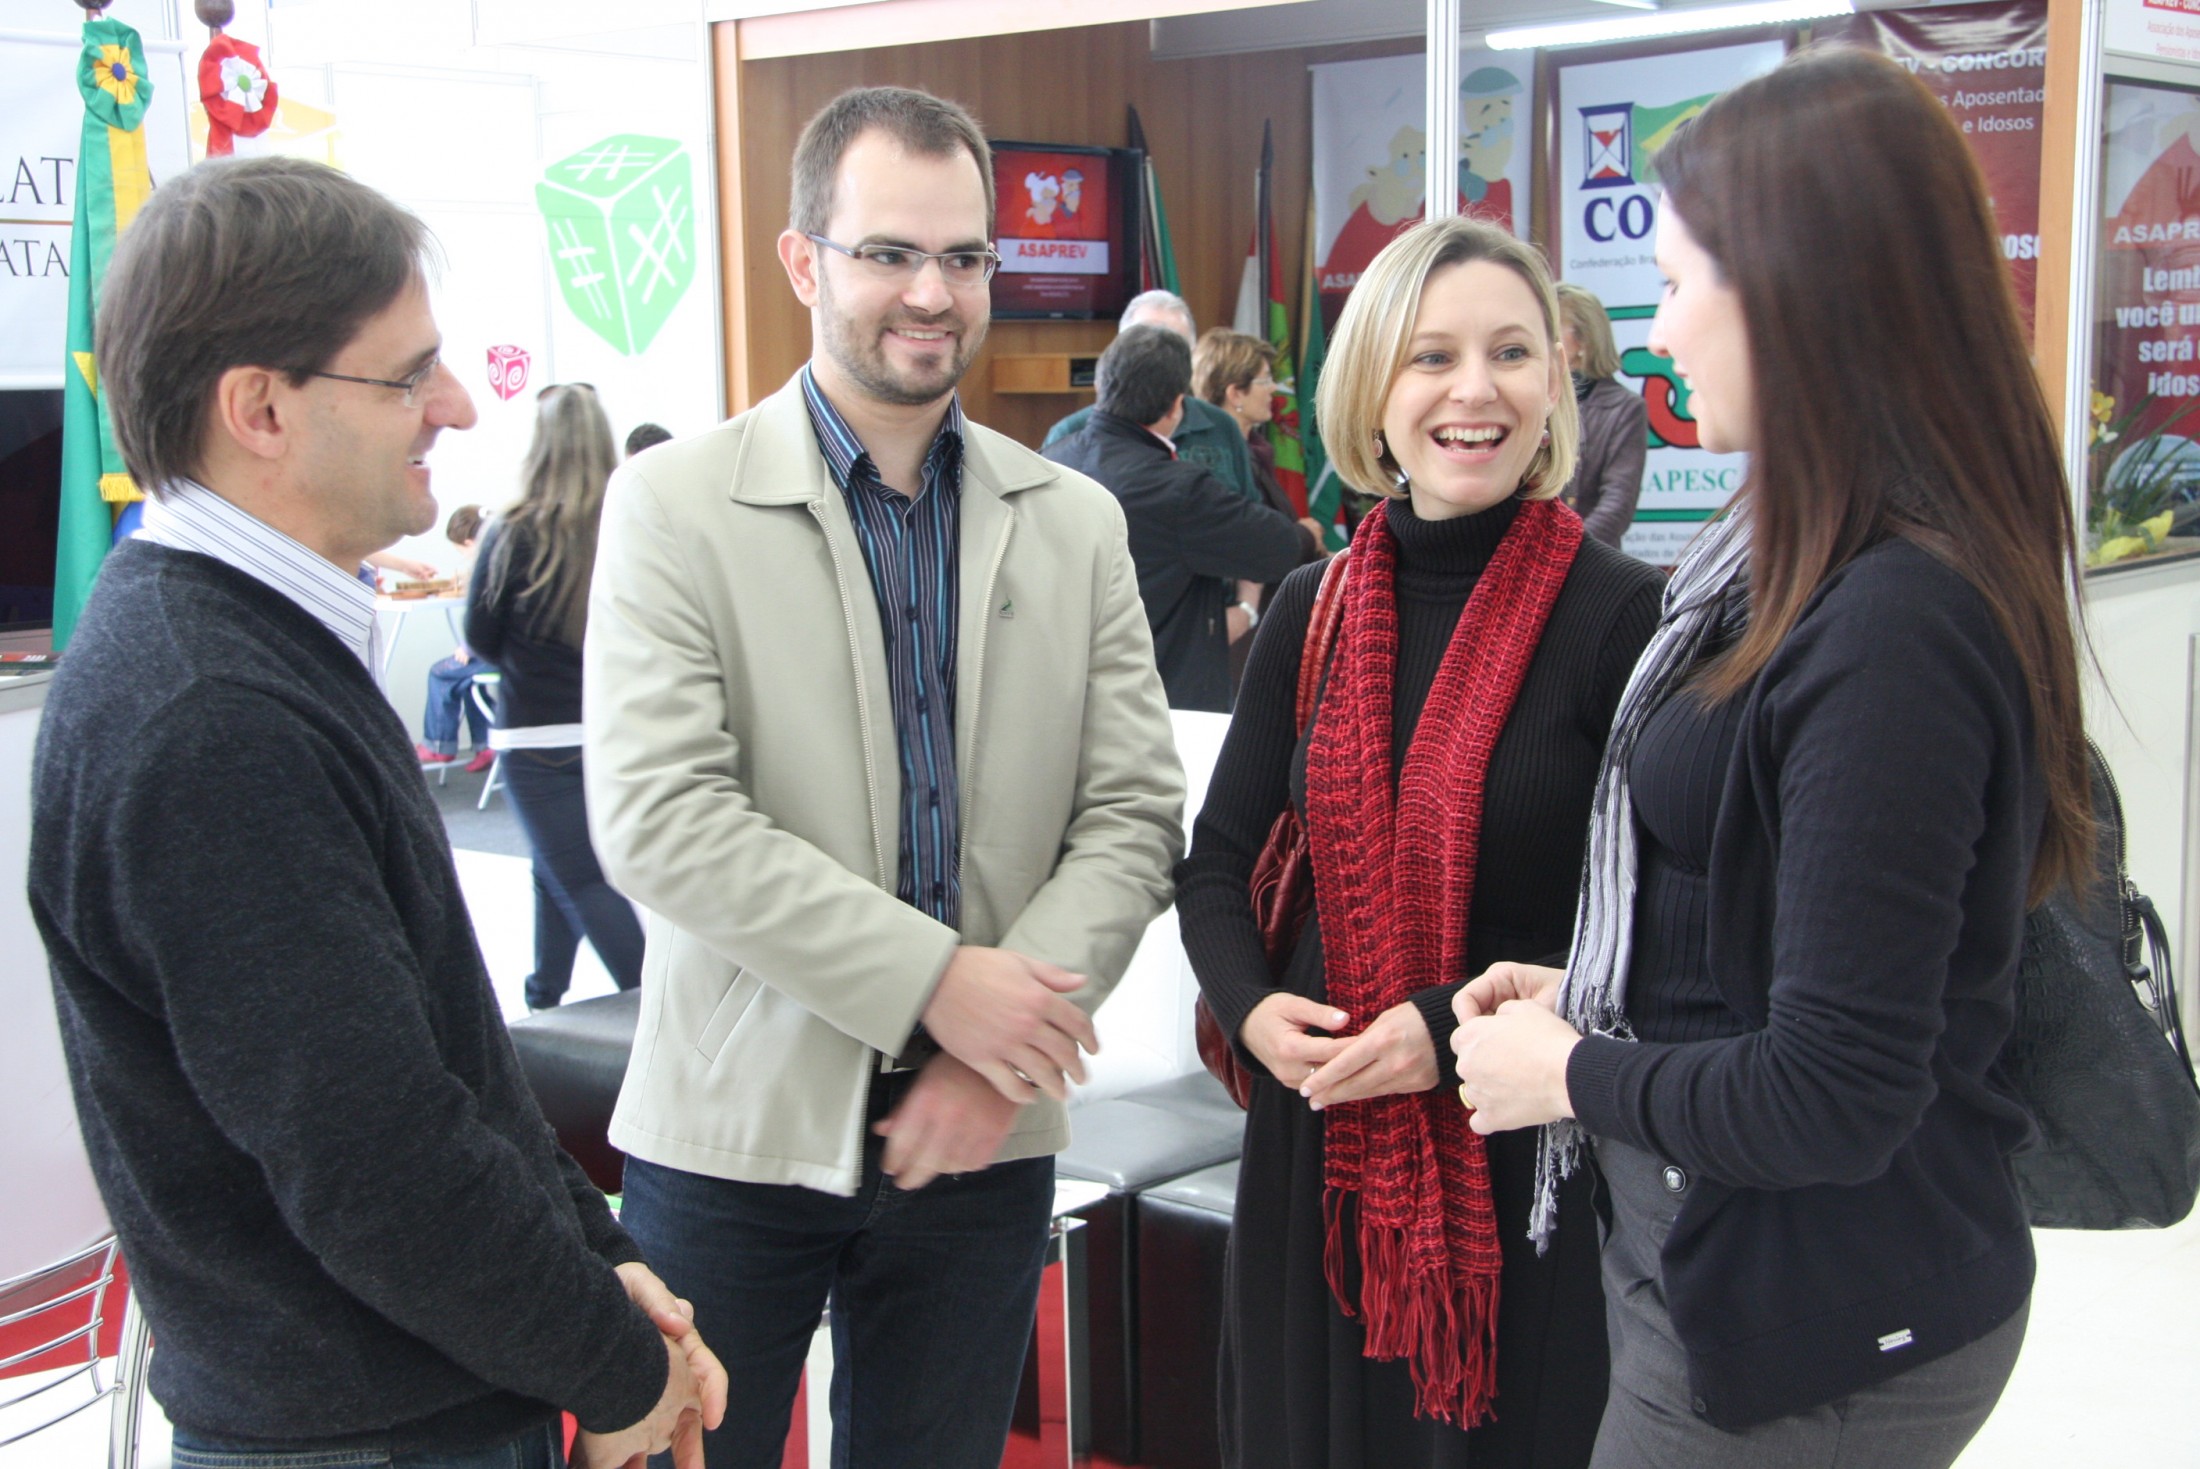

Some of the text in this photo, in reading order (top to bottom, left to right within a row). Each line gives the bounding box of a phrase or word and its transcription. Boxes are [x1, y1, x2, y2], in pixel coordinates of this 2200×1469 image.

[1962, 115, 2034, 133] e Idosos
[0, 155, 74, 206] AT
[1017, 243, 1089, 259] ASAPREV
[2115, 301, 2174, 328] você
[2138, 335, 2193, 362] será
[1641, 467, 1738, 493] APESC
